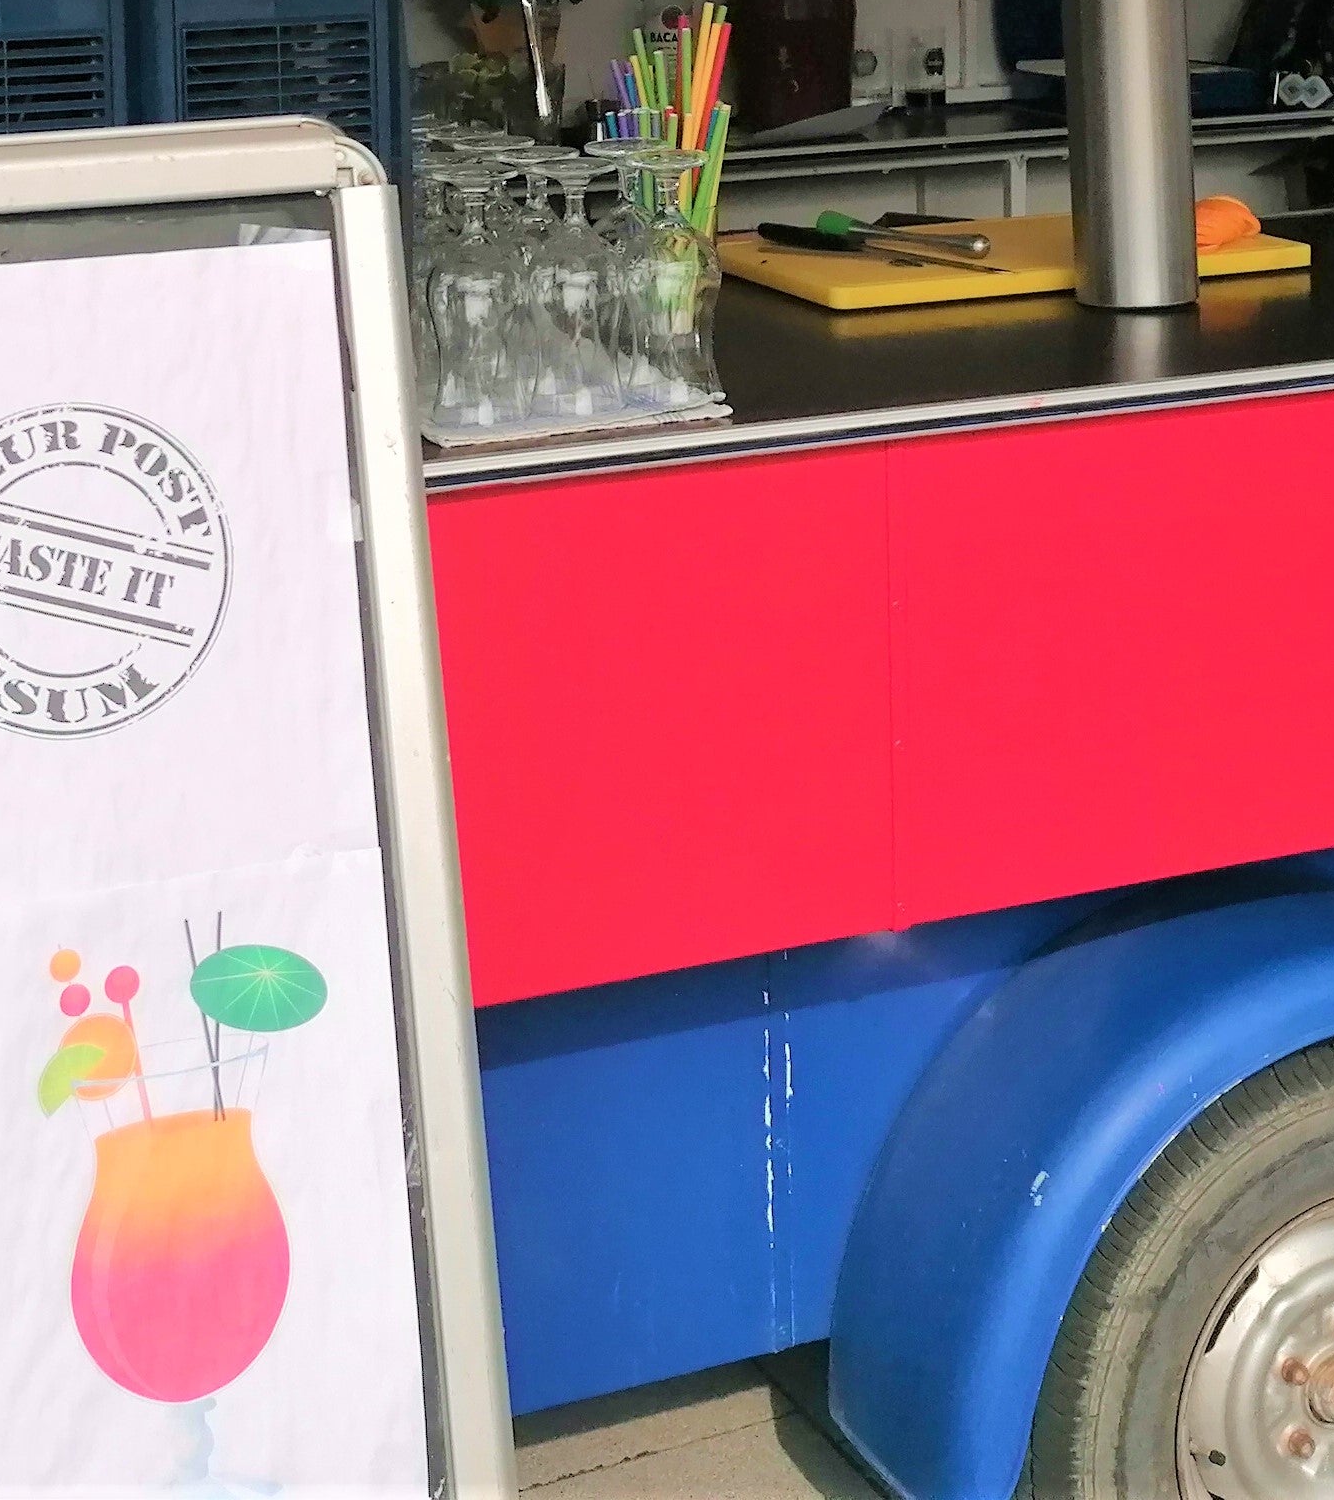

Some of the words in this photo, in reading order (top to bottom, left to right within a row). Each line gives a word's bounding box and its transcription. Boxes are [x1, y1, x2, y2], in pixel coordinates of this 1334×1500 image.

[649, 31, 678, 43] BACA
[100, 422, 214, 537] POST
[121, 565, 176, 609] IT
